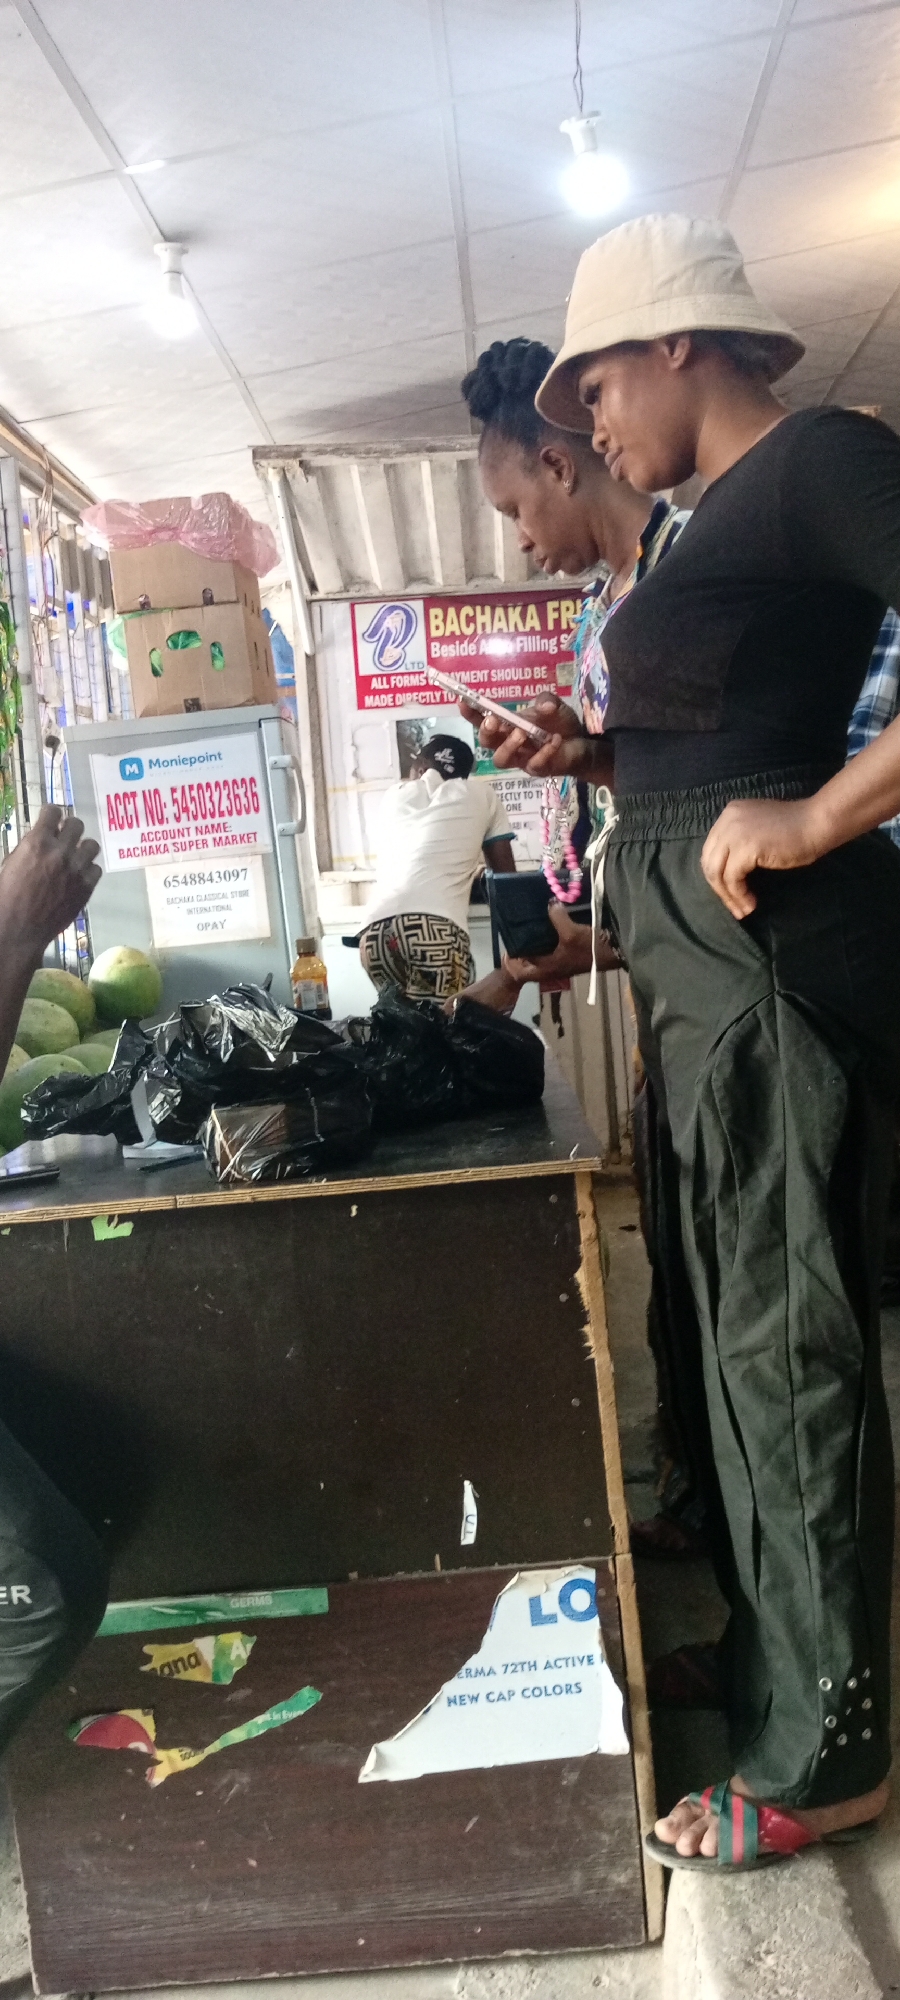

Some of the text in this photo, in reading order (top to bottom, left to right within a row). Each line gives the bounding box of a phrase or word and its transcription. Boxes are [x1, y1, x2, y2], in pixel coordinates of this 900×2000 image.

[429, 603, 542, 638] BACHAKA
[430, 640, 477, 658] Beside
[516, 636, 558, 654] Filling
[405, 662, 425, 671] LTD
[371, 676, 389, 690] ALL
[390, 673, 427, 687] FORMS
[444, 669, 490, 684] AYMENT
[491, 667, 532, 681] SHOULD
[533, 666, 548, 679] BE
[364, 693, 395, 708] MADE
[395, 689, 442, 706] DIRECTLY
[148, 752, 223, 769] Moniepoint
[505, 781, 515, 790] OF
[523, 791, 534, 800] TO
[106, 777, 260, 831] ACCT NO: 5450323636
[141, 822, 232, 843] ACCOUNT NAME:
[118, 832, 258, 859] BACHAKA SUPER MARKET
[163, 868, 248, 889] 6548843097
[166, 889, 250, 905] BACHAKA CLASSICAL STORE
[186, 904, 233, 915] INTERNATIONAL
[196, 919, 227, 931] OPAY
[230, 1595, 273, 1608] GERMS
[149, 1652, 201, 1678] ana
[502, 1660, 538, 1674] 72TH
[543, 1654, 595, 1670] ACTIVE
[446, 1682, 583, 1707] NEW CAP COLORS
